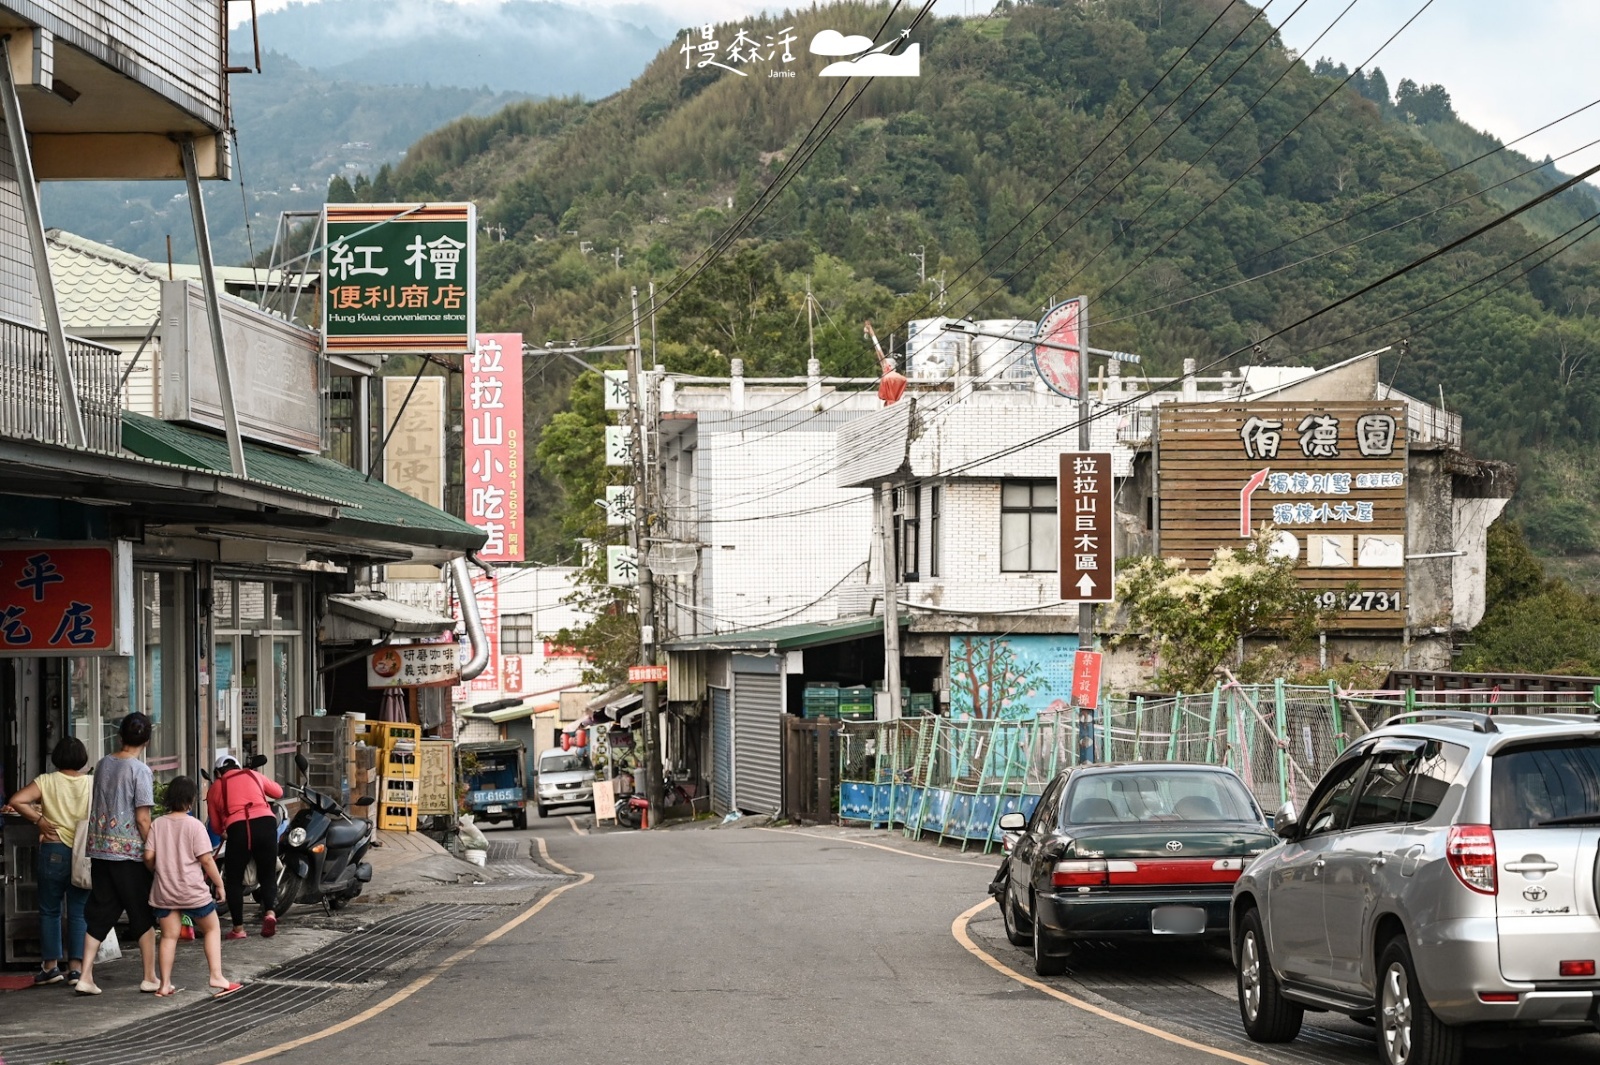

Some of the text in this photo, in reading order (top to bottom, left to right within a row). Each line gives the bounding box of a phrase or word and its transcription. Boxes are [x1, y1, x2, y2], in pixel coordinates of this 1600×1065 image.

[329, 234, 466, 281] 紅檜
[329, 284, 466, 309] 便利商店
[329, 313, 356, 323] Hung
[383, 314, 442, 322] convenience
[443, 313, 466, 321] store
[470, 339, 505, 556] 拉拉山小吃店
[1240, 414, 1397, 458] 侑德園
[508, 429, 518, 530] 0928415621
[1269, 473, 1351, 493] 獨棟別墅
[1073, 456, 1099, 571] 拉拉山巨木區
[1273, 502, 1374, 523] 獨棟小木屋
[403, 648, 454, 661] 研磨咖啡
[405, 663, 454, 676] 義式咖啡
